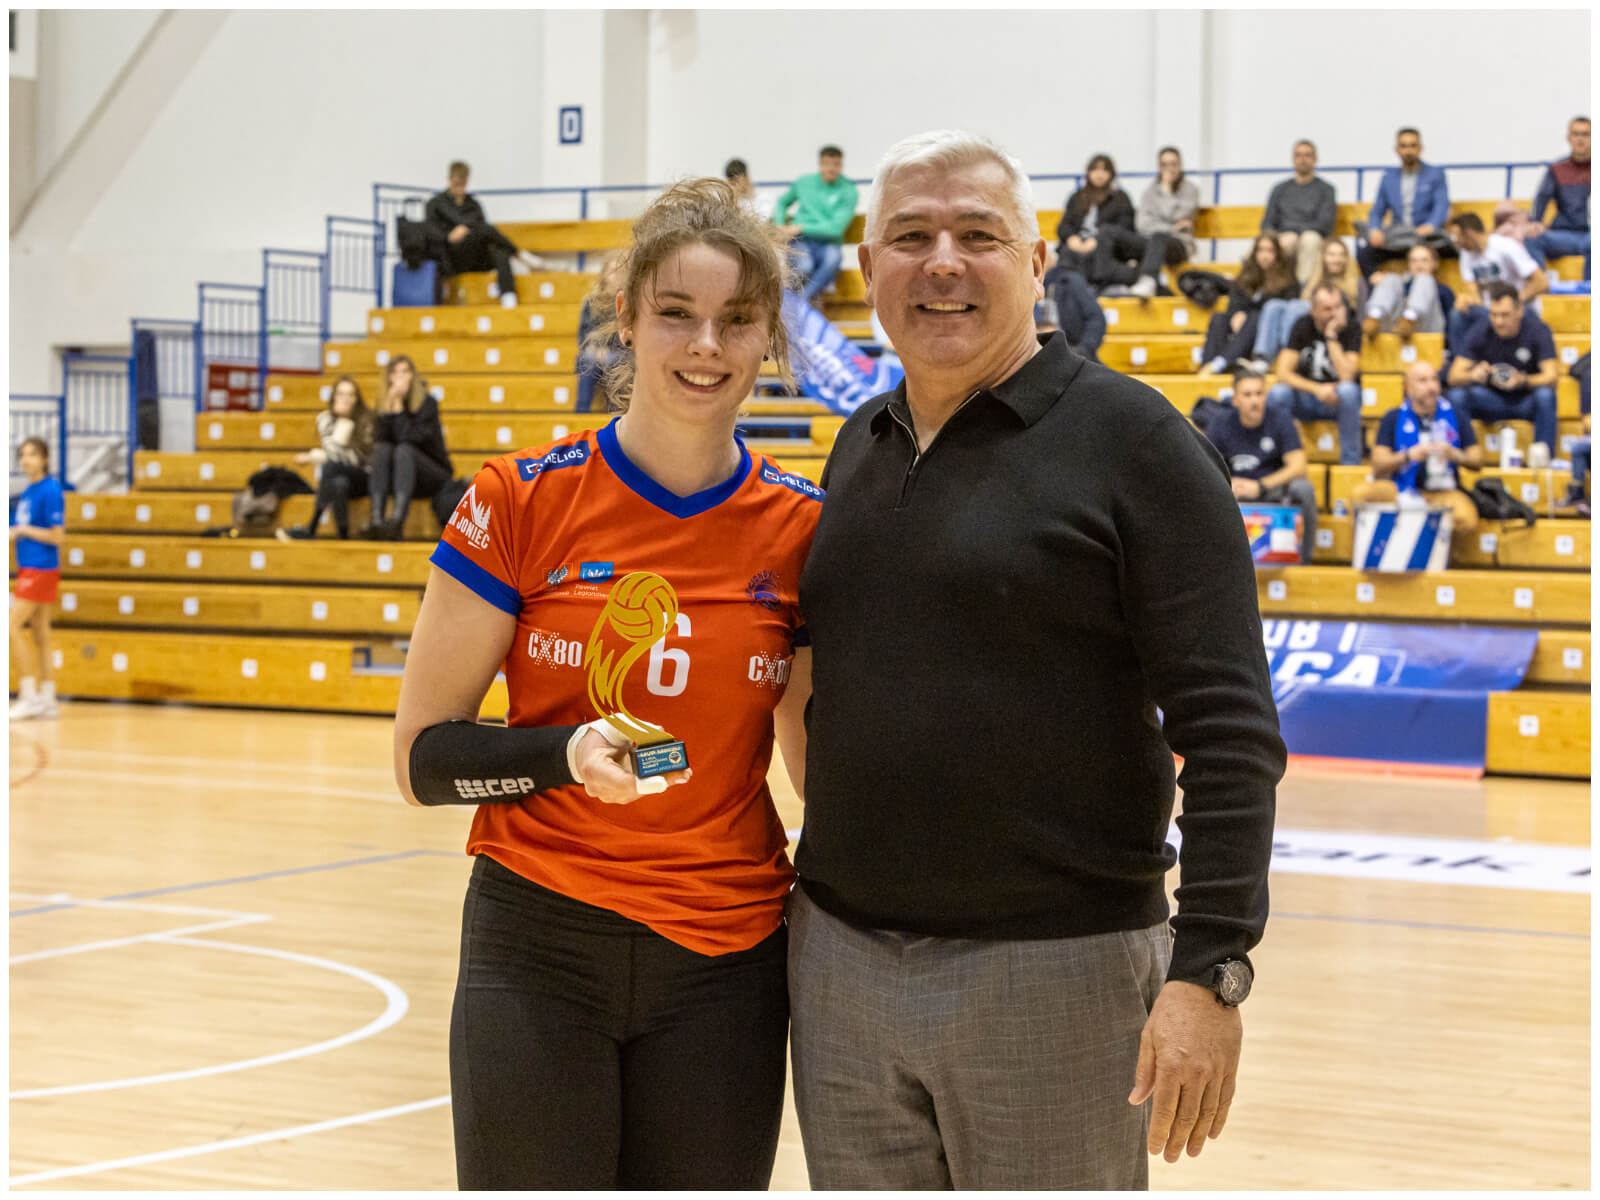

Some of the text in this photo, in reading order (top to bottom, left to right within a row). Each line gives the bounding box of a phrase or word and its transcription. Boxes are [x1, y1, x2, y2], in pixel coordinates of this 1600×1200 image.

[456, 515, 491, 550] JONIEC
[528, 628, 583, 670] CX80
[1262, 619, 1321, 650] UB
[646, 612, 692, 697] 6
[1265, 650, 1380, 688] CA
